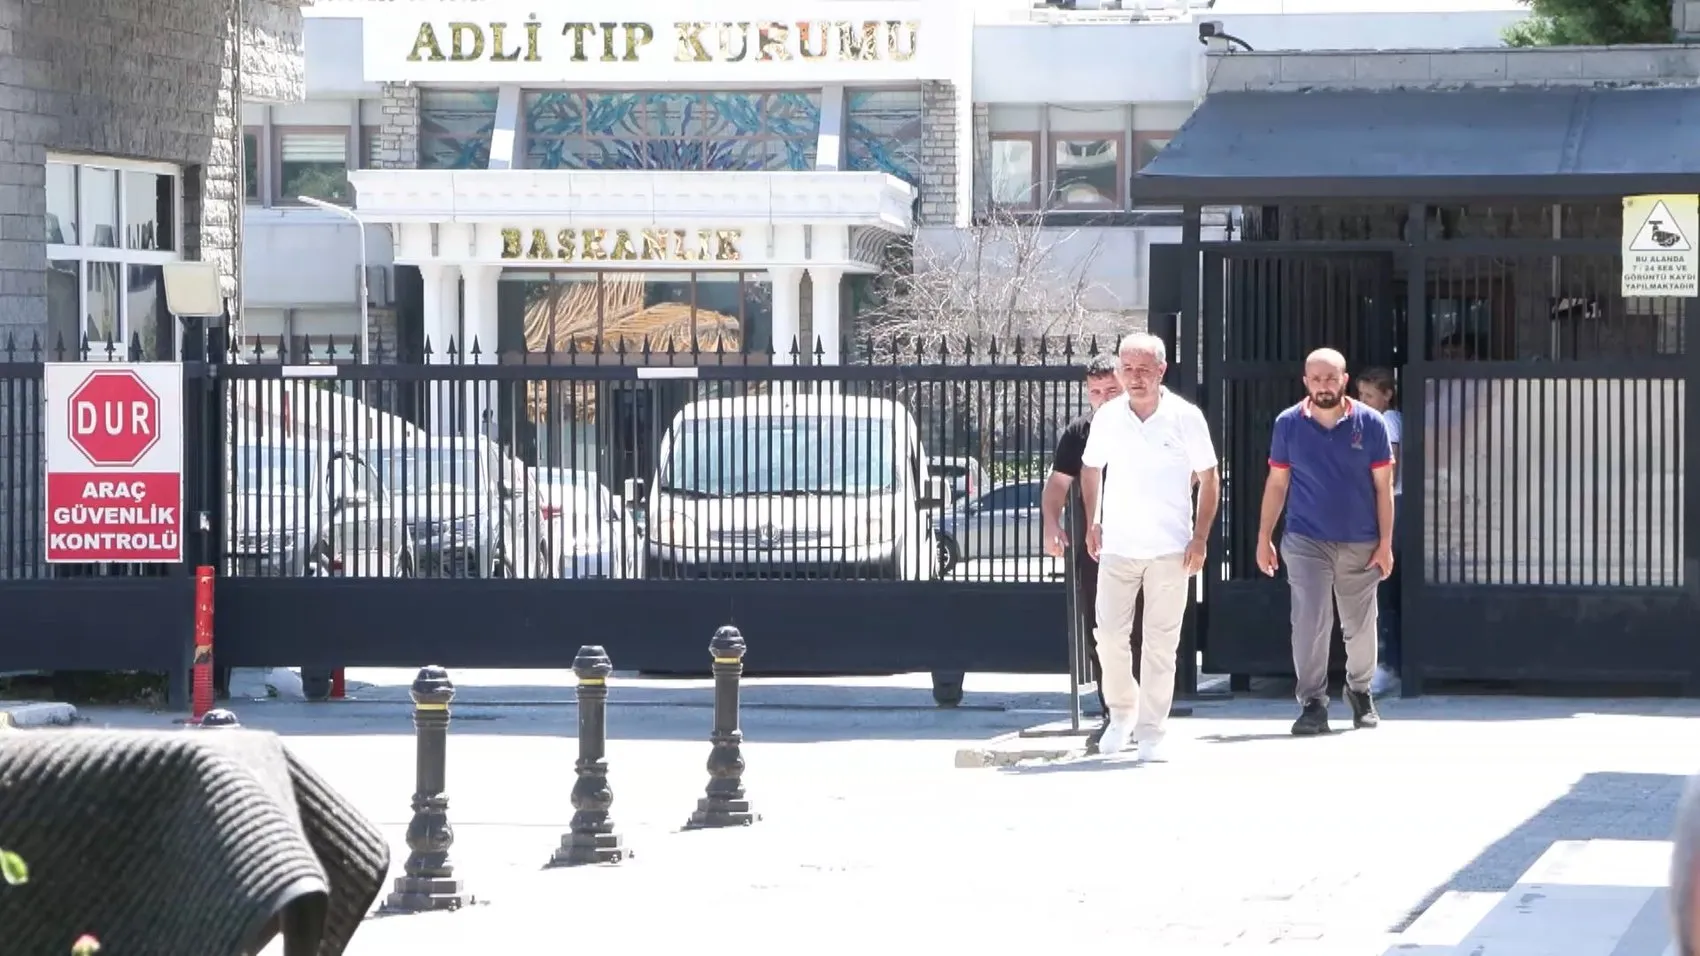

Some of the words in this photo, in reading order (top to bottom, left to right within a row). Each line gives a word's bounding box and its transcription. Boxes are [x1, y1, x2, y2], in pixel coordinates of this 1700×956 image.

[406, 12, 542, 62] ADLİ
[561, 21, 654, 62] TIP
[673, 20, 922, 63] KURUMU
[500, 228, 743, 262] BAŞKANLIK
[77, 401, 150, 435] DUR
[82, 481, 146, 503] ARAÇ
[53, 503, 176, 525] GÜVENLİK
[50, 529, 178, 550] KONTROLÜ
